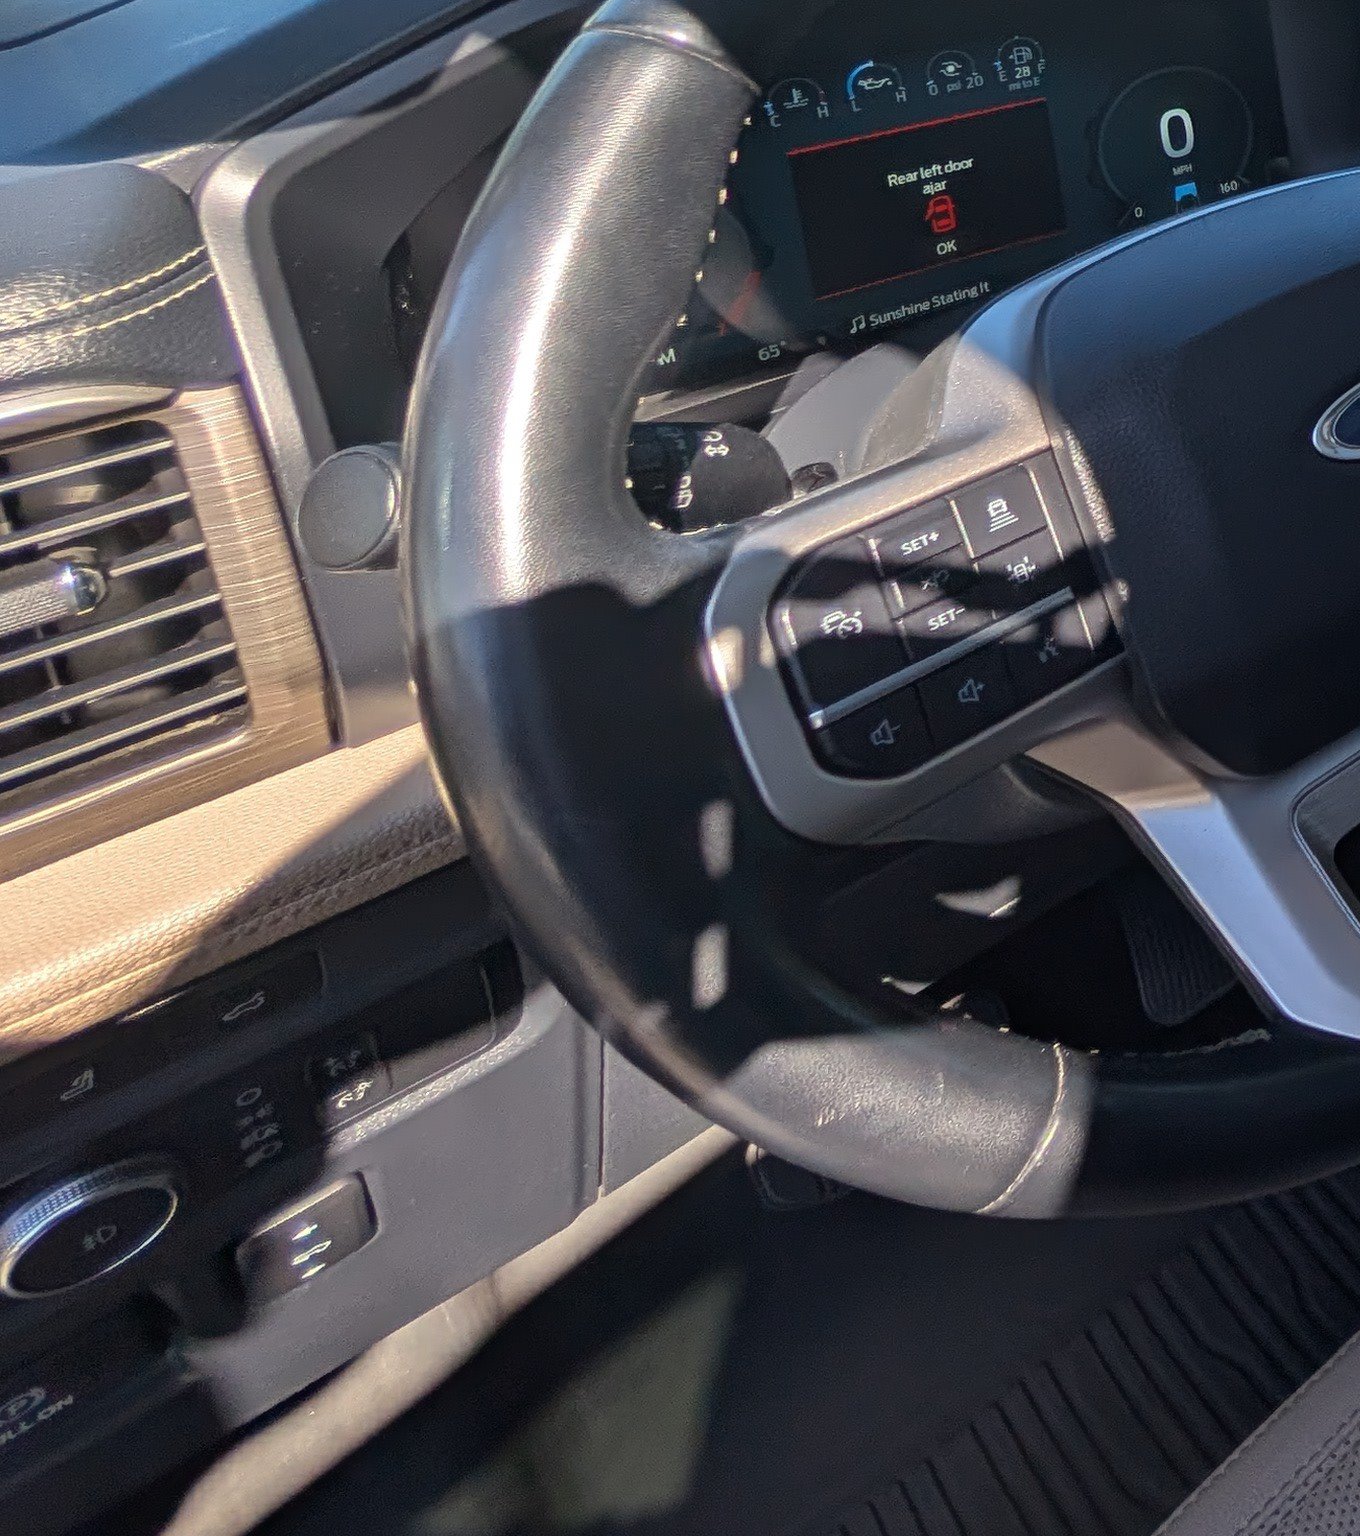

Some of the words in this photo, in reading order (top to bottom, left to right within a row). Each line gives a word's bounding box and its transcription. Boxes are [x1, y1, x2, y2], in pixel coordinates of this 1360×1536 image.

[1014, 65, 1031, 79] 28
[1037, 62, 1047, 74] F
[965, 75, 984, 90] 20
[999, 70, 1008, 82] E
[929, 83, 939, 96] 0
[895, 91, 907, 103] H
[817, 105, 829, 118] H
[852, 100, 862, 112] L
[770, 116, 781, 128] C
[1160, 108, 1194, 158] 0
[887, 170, 918, 188] Rear
[920, 165, 942, 180] left
[943, 157, 974, 175] door
[1172, 163, 1193, 176] MPH
[922, 179, 947, 195] ajar
[1220, 180, 1238, 194] 160
[1134, 206, 1143, 218] 0
[936, 240, 958, 257] OK
[869, 299, 931, 329] Sunshine
[931, 288, 979, 311] Stating
[979, 280, 990, 296] It
[901, 531, 940, 557] SET+
[37, 1394, 73, 1420] ON
